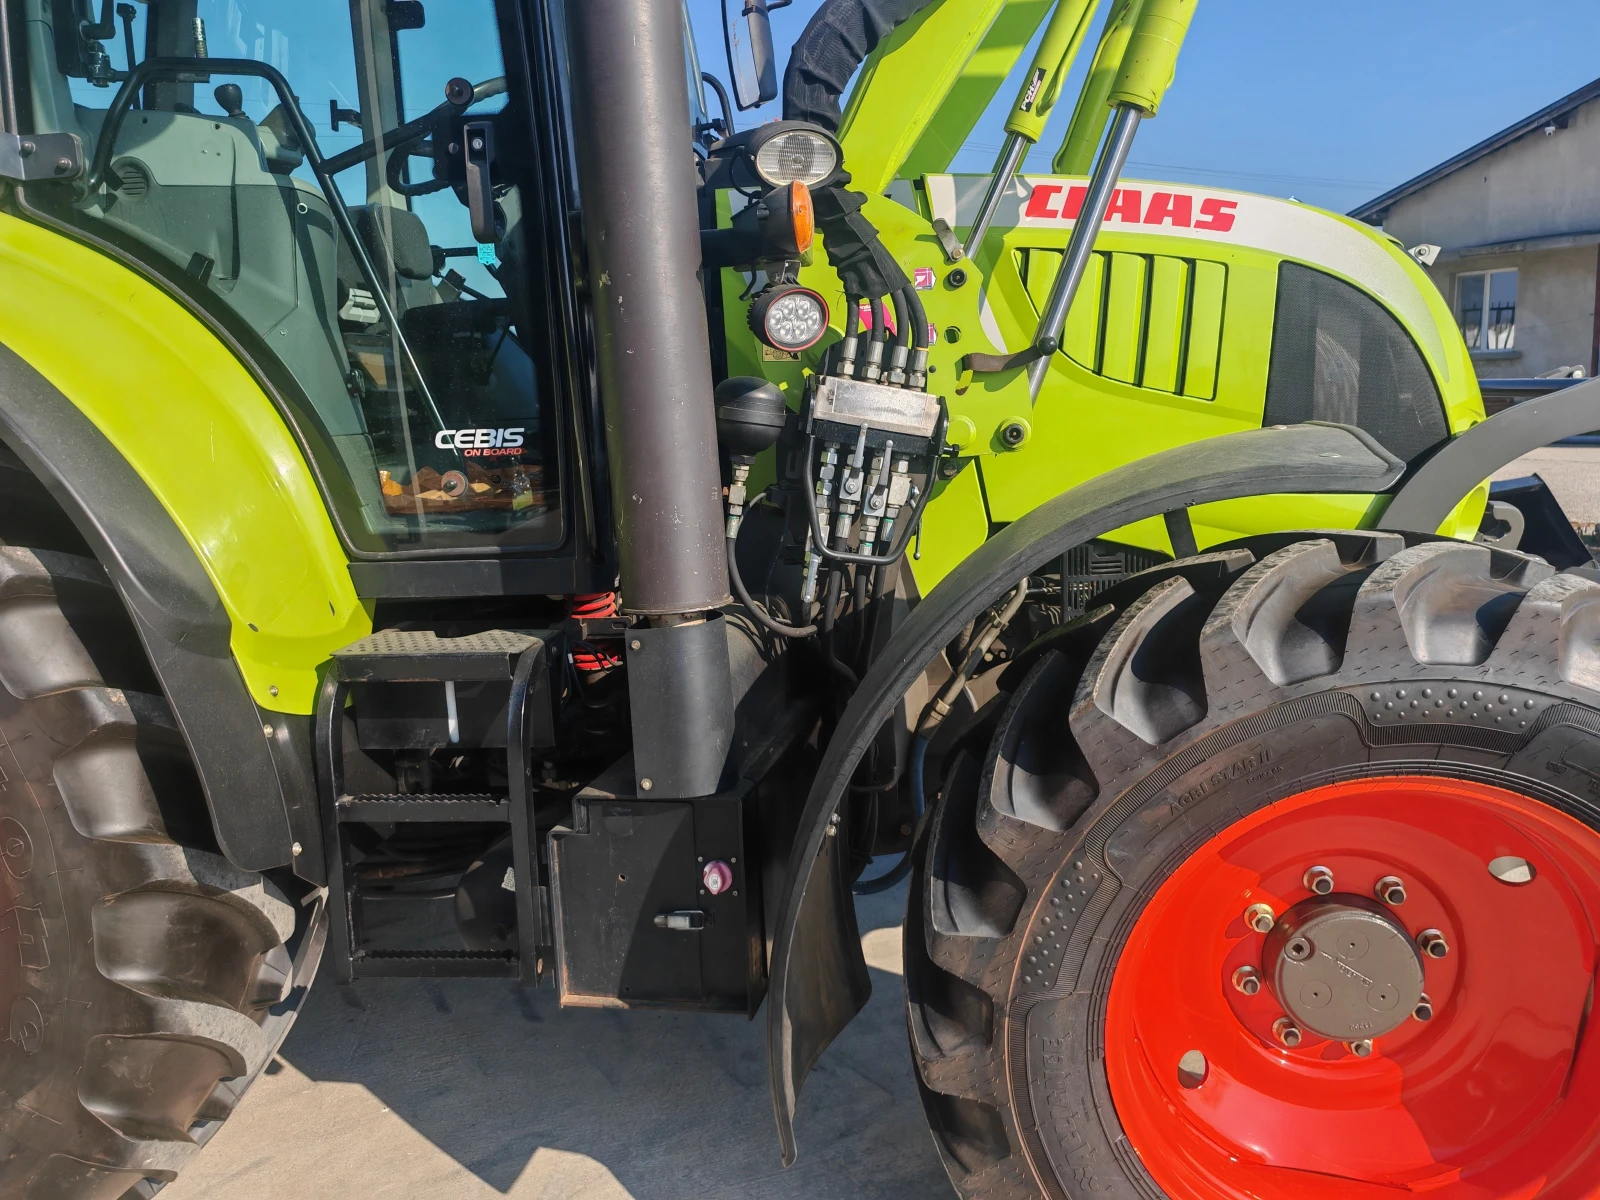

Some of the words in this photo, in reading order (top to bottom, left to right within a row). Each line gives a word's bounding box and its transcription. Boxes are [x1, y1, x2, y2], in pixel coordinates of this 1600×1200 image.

[1025, 184, 1239, 232] CLAAS
[434, 428, 525, 449] CEBIS
[464, 449, 481, 457] ON
[483, 448, 522, 456] BOARD
[1169, 781, 1208, 816] AGRI
[1211, 755, 1257, 787] STAR
[1042, 1038, 1096, 1168] ALLIANCE
